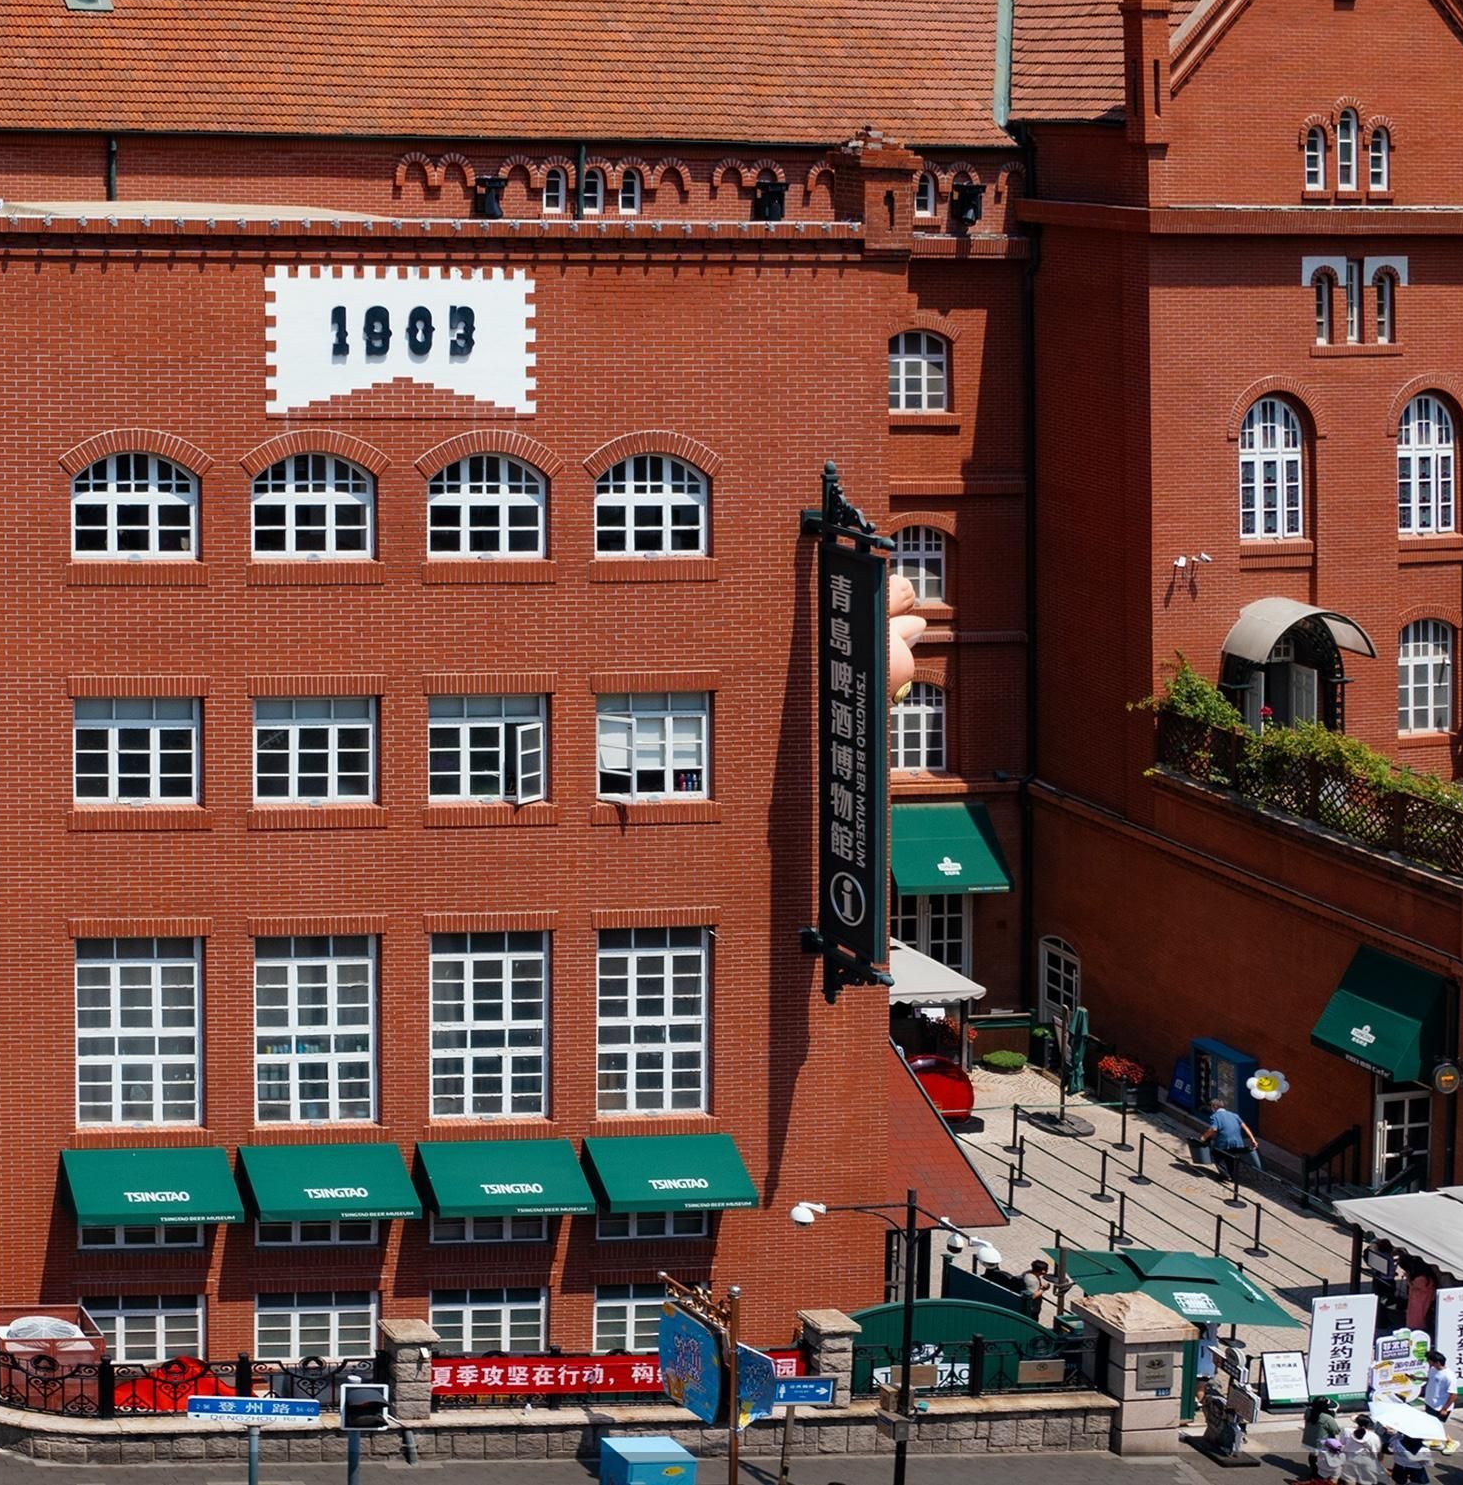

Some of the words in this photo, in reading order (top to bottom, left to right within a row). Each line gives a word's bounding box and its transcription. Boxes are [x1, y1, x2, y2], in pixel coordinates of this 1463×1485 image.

[331, 305, 476, 356] 1903
[856, 671, 867, 748] TSINGTAO
[856, 751, 867, 793] BEER
[856, 794, 866, 869] MUSEUM
[480, 1183, 544, 1195] TSINGTAO
[648, 1178, 709, 1190] TSINGTAO
[124, 1191, 190, 1203] TSINGTAO
[304, 1187, 369, 1199] TSINGTAO
[1326, 1318, 1356, 1388] 已预约通道
[218, 1401, 291, 1414] 登州路
[210, 1413, 278, 1422] DENGZHOU
